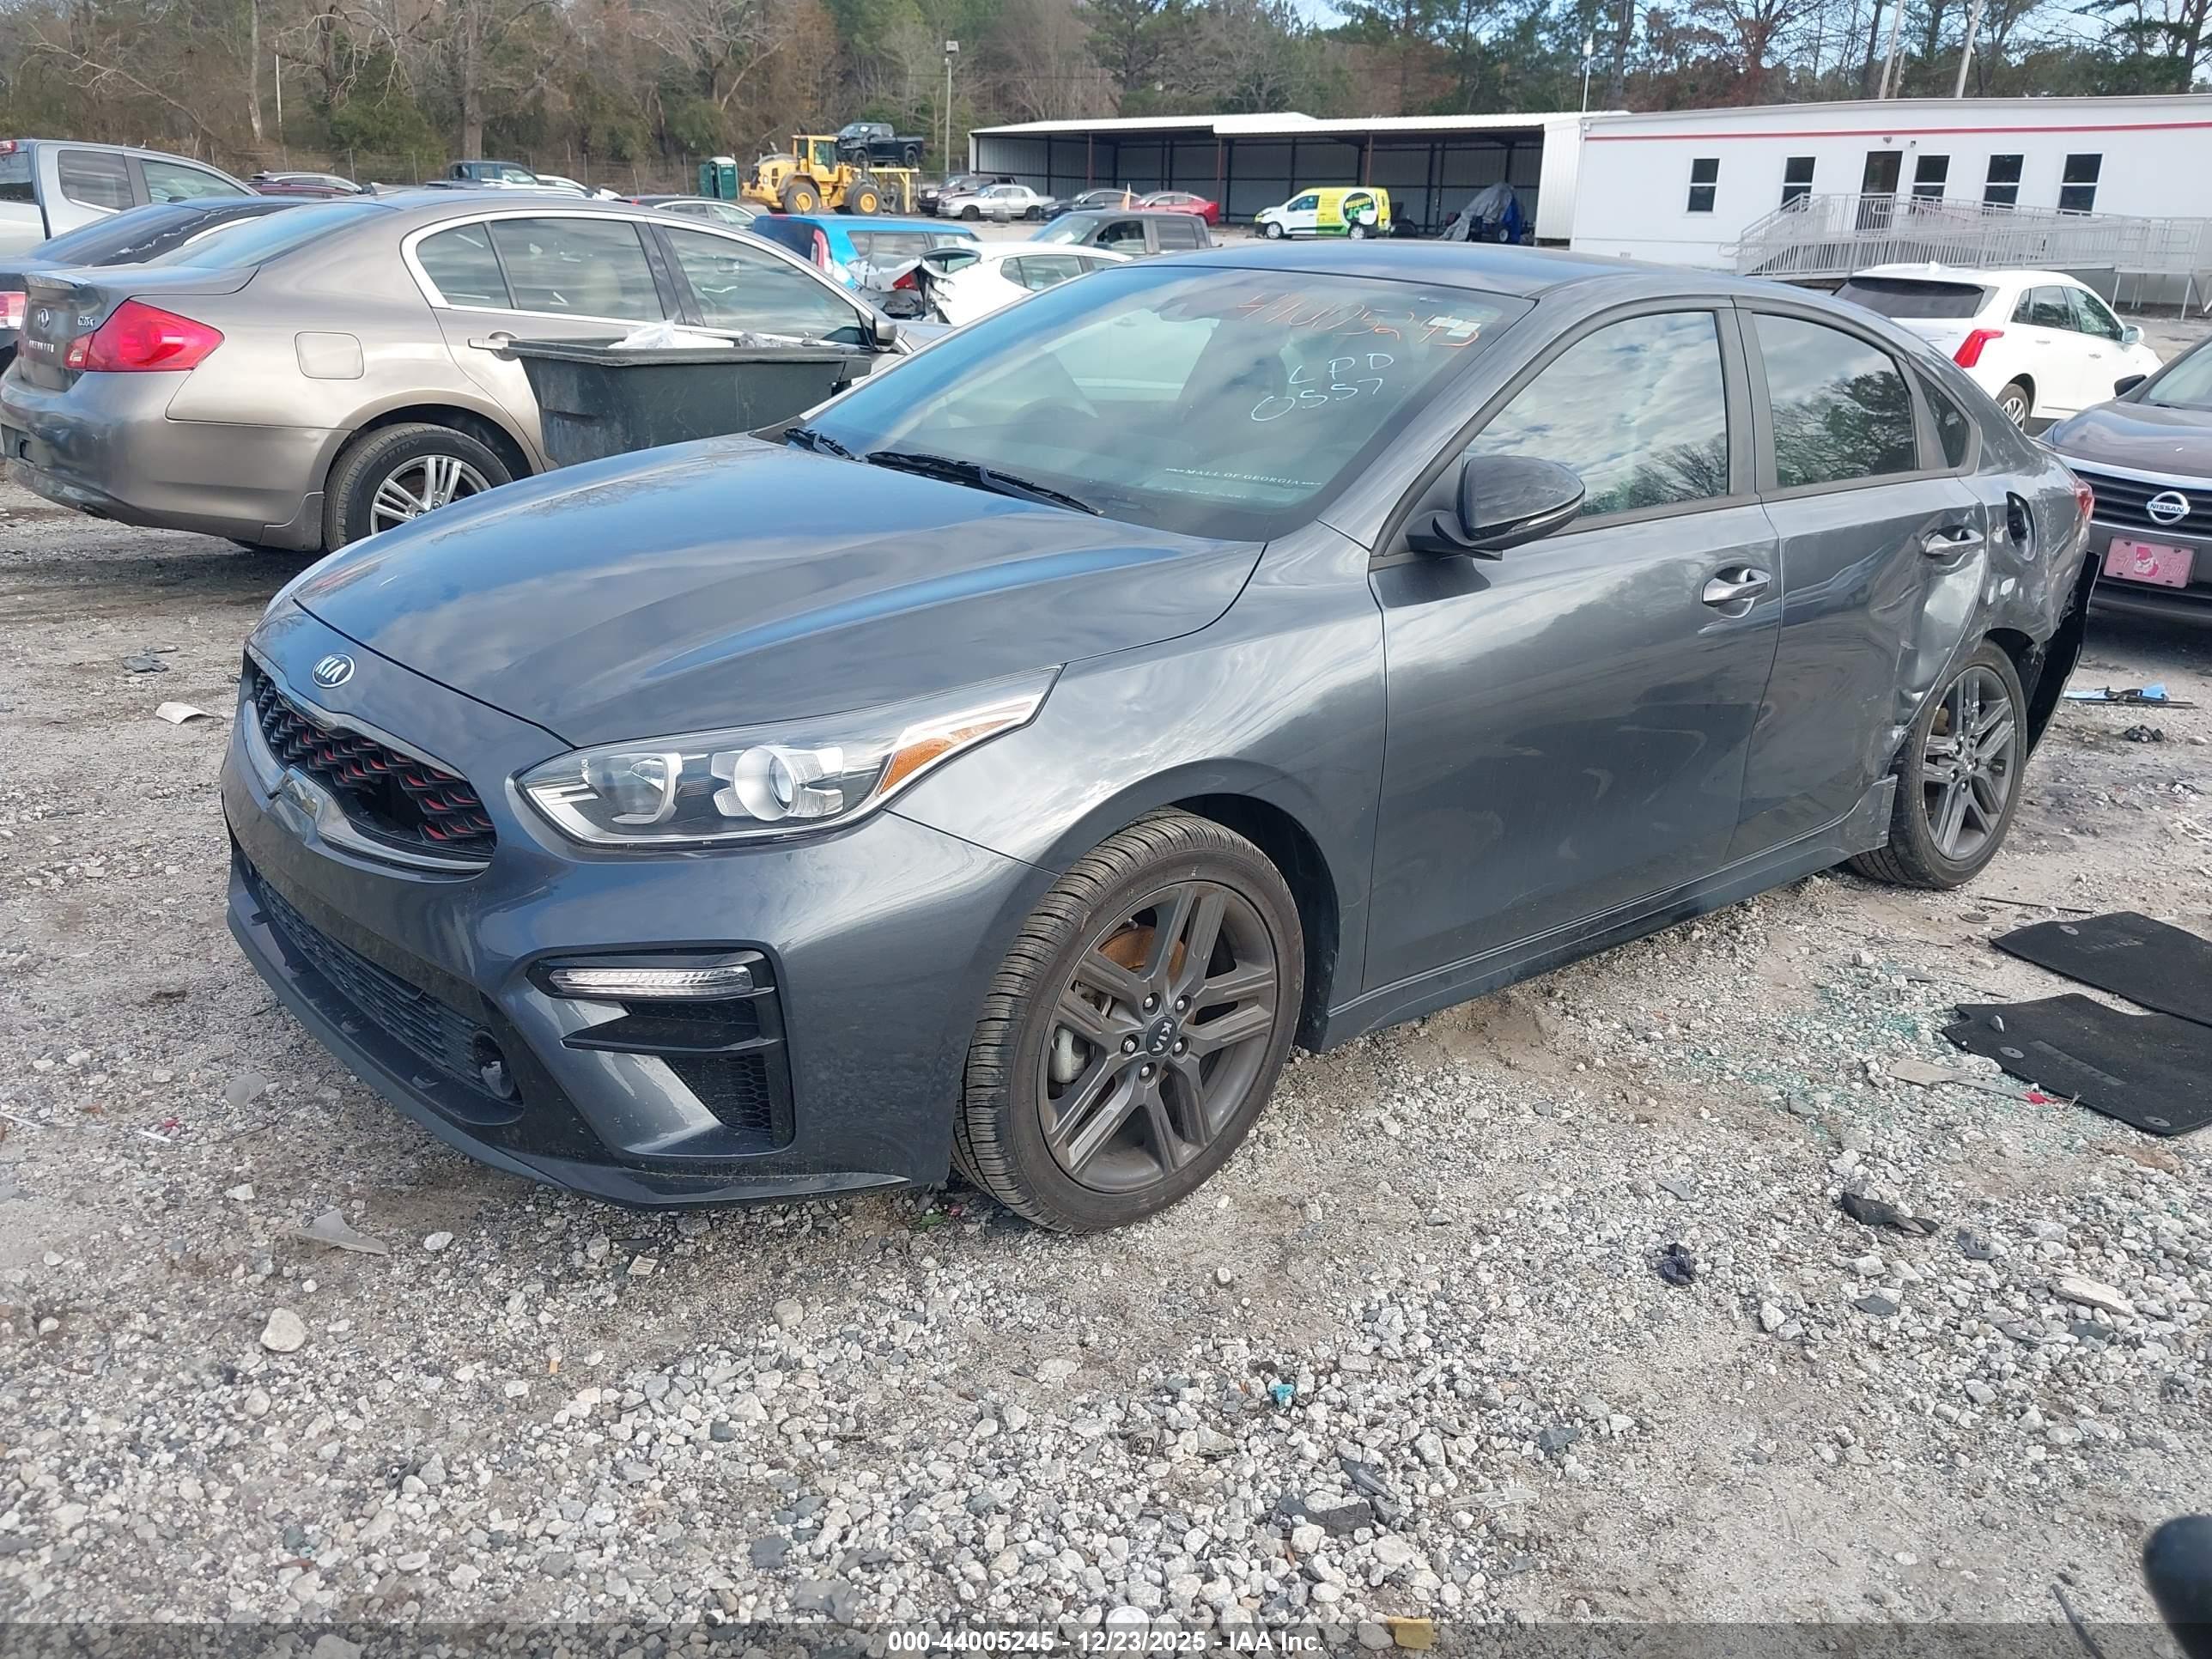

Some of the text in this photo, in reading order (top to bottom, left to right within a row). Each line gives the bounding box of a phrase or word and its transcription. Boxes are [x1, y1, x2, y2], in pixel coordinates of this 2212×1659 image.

[1251, 378, 1383, 421] 0557
[1184, 468, 1218, 477] MALL
[1244, 474, 1299, 486] GEORGIA
[2149, 502, 2185, 513] NISSAN
[315, 655, 347, 683] KIA
[1152, 1022, 1173, 1052] KIA
